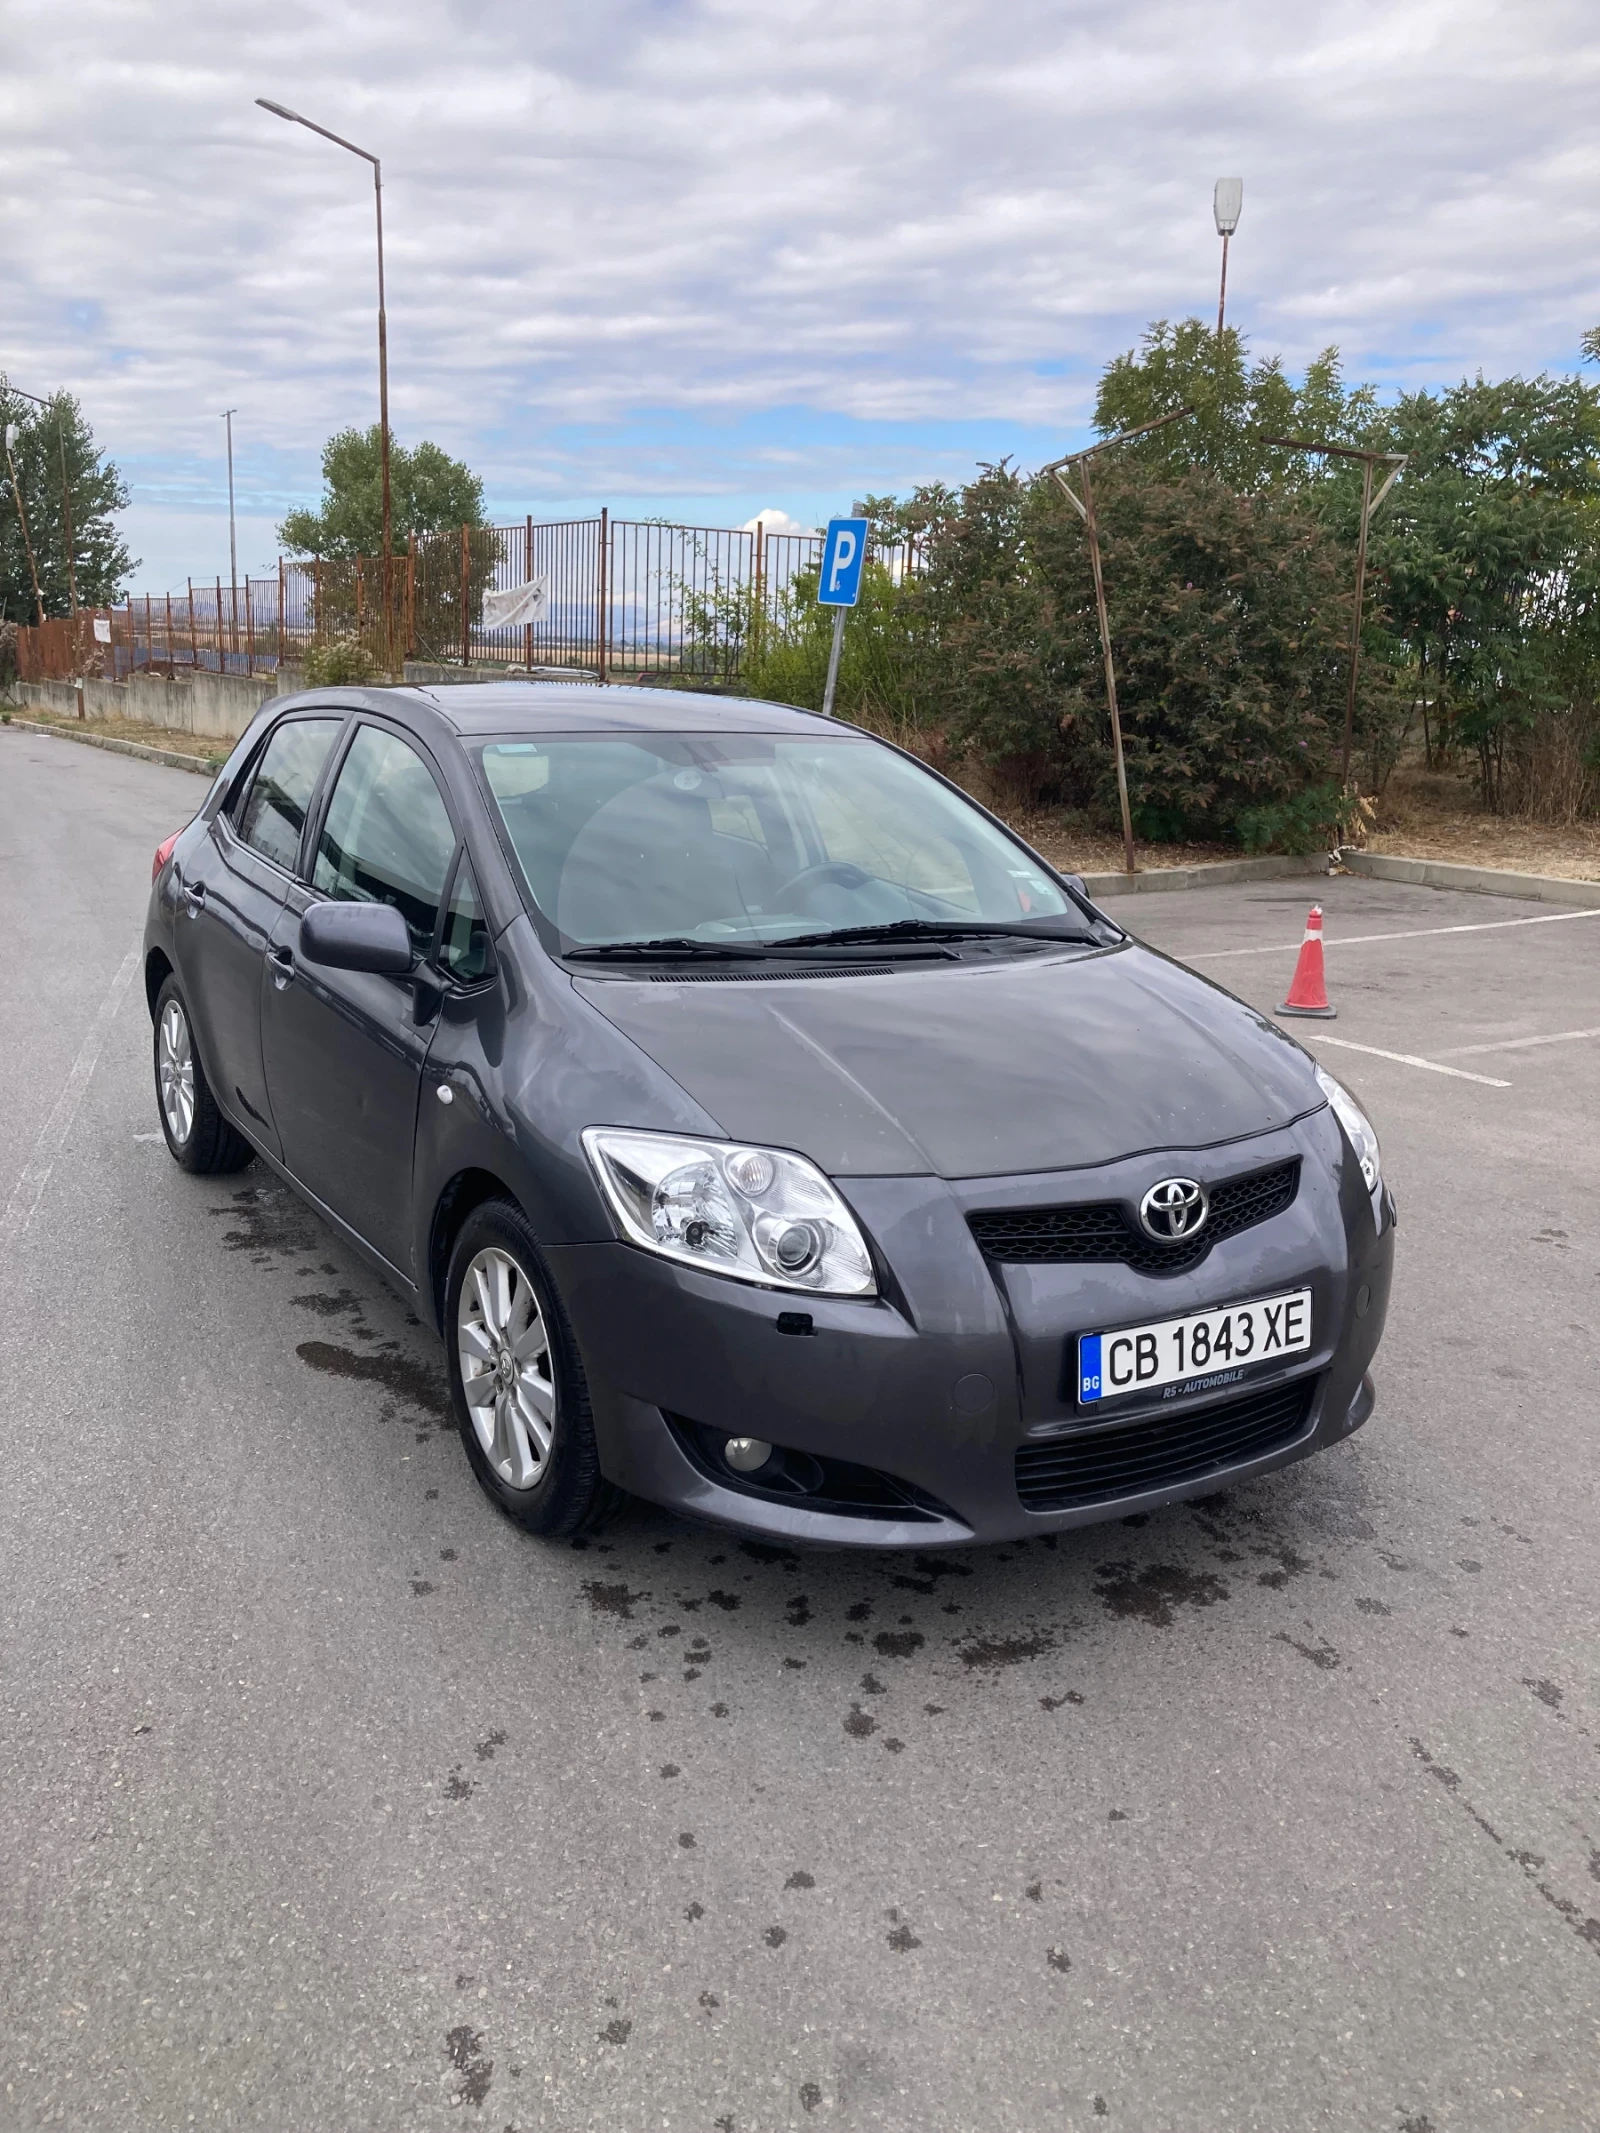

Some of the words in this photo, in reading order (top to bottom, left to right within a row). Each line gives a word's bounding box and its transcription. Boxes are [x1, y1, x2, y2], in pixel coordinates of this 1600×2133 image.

[829, 531, 856, 592] P
[1109, 1333, 1159, 1386] CB
[1172, 1312, 1255, 1373] 1843
[1263, 1299, 1304, 1352] XE
[1082, 1375, 1100, 1392] BG
